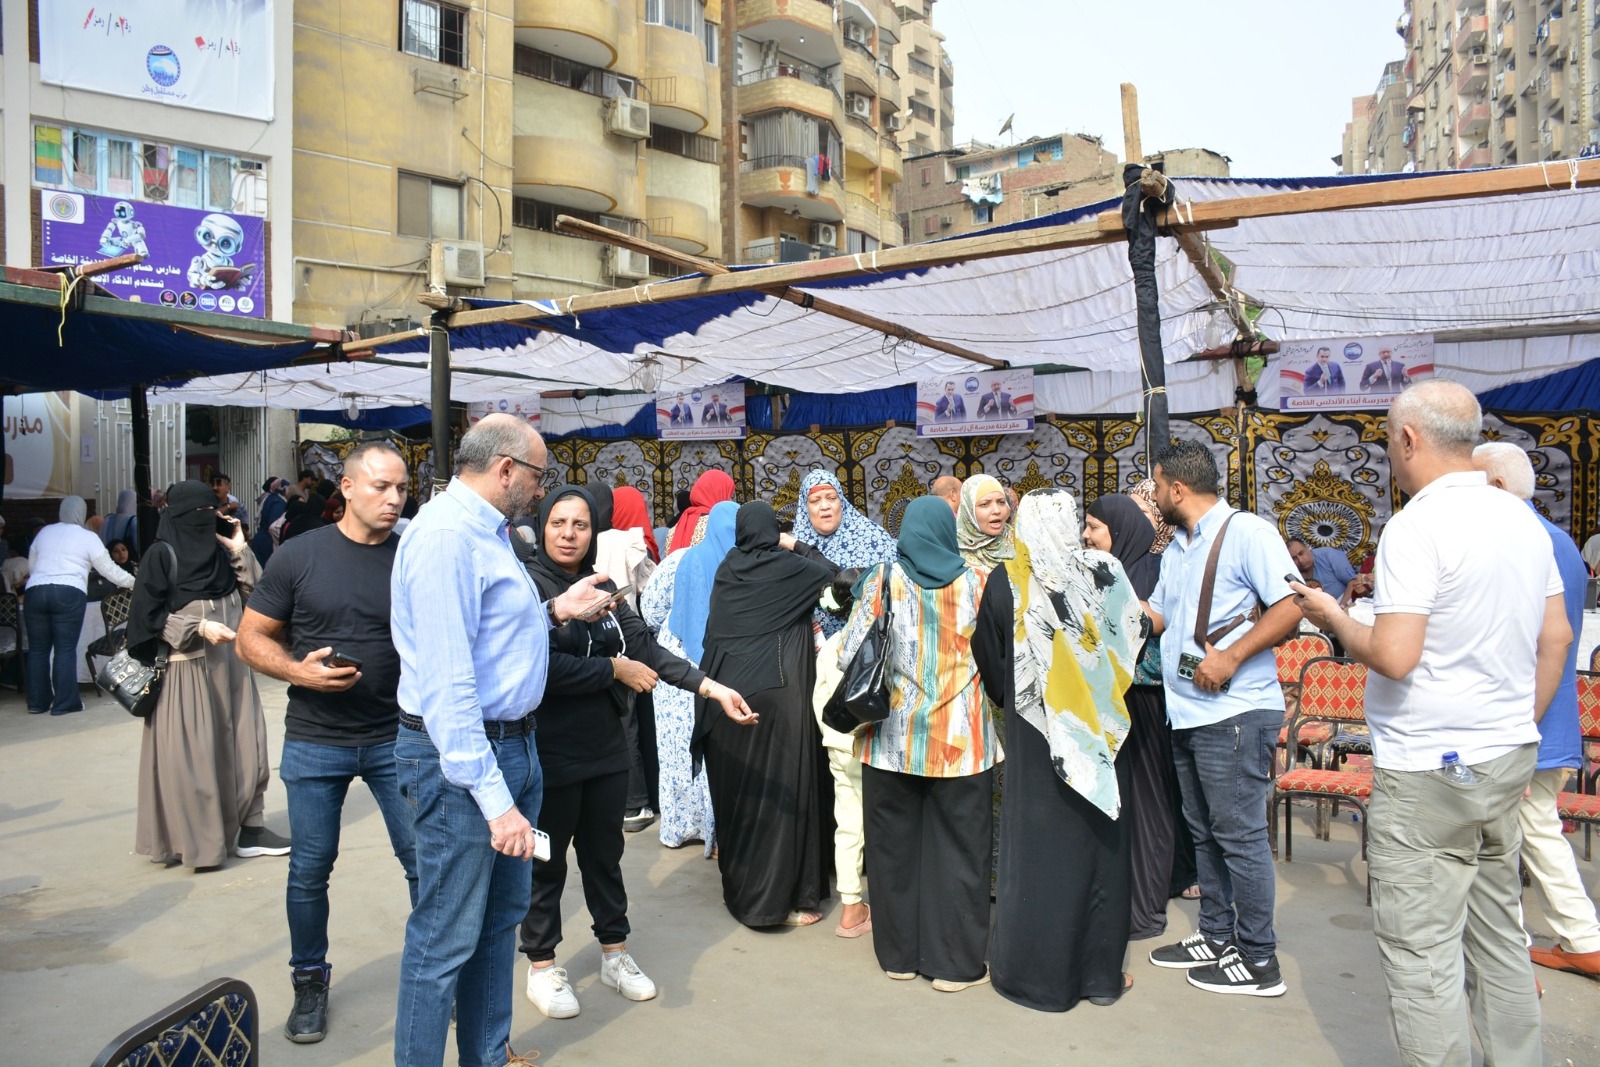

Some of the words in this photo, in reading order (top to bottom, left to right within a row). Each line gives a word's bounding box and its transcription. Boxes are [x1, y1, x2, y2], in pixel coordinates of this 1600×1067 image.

[154, 86, 175, 97] مستقبل
[51, 252, 79, 265] الخاصة
[133, 262, 154, 272] حسام
[155, 264, 181, 275] مدارس
[111, 276, 133, 285] الذكاء
[134, 279, 165, 288] تستخدم
[1316, 397, 1345, 407] الأندلس
[1346, 396, 1361, 405] أبناء
[84, 444, 91, 457] 1
